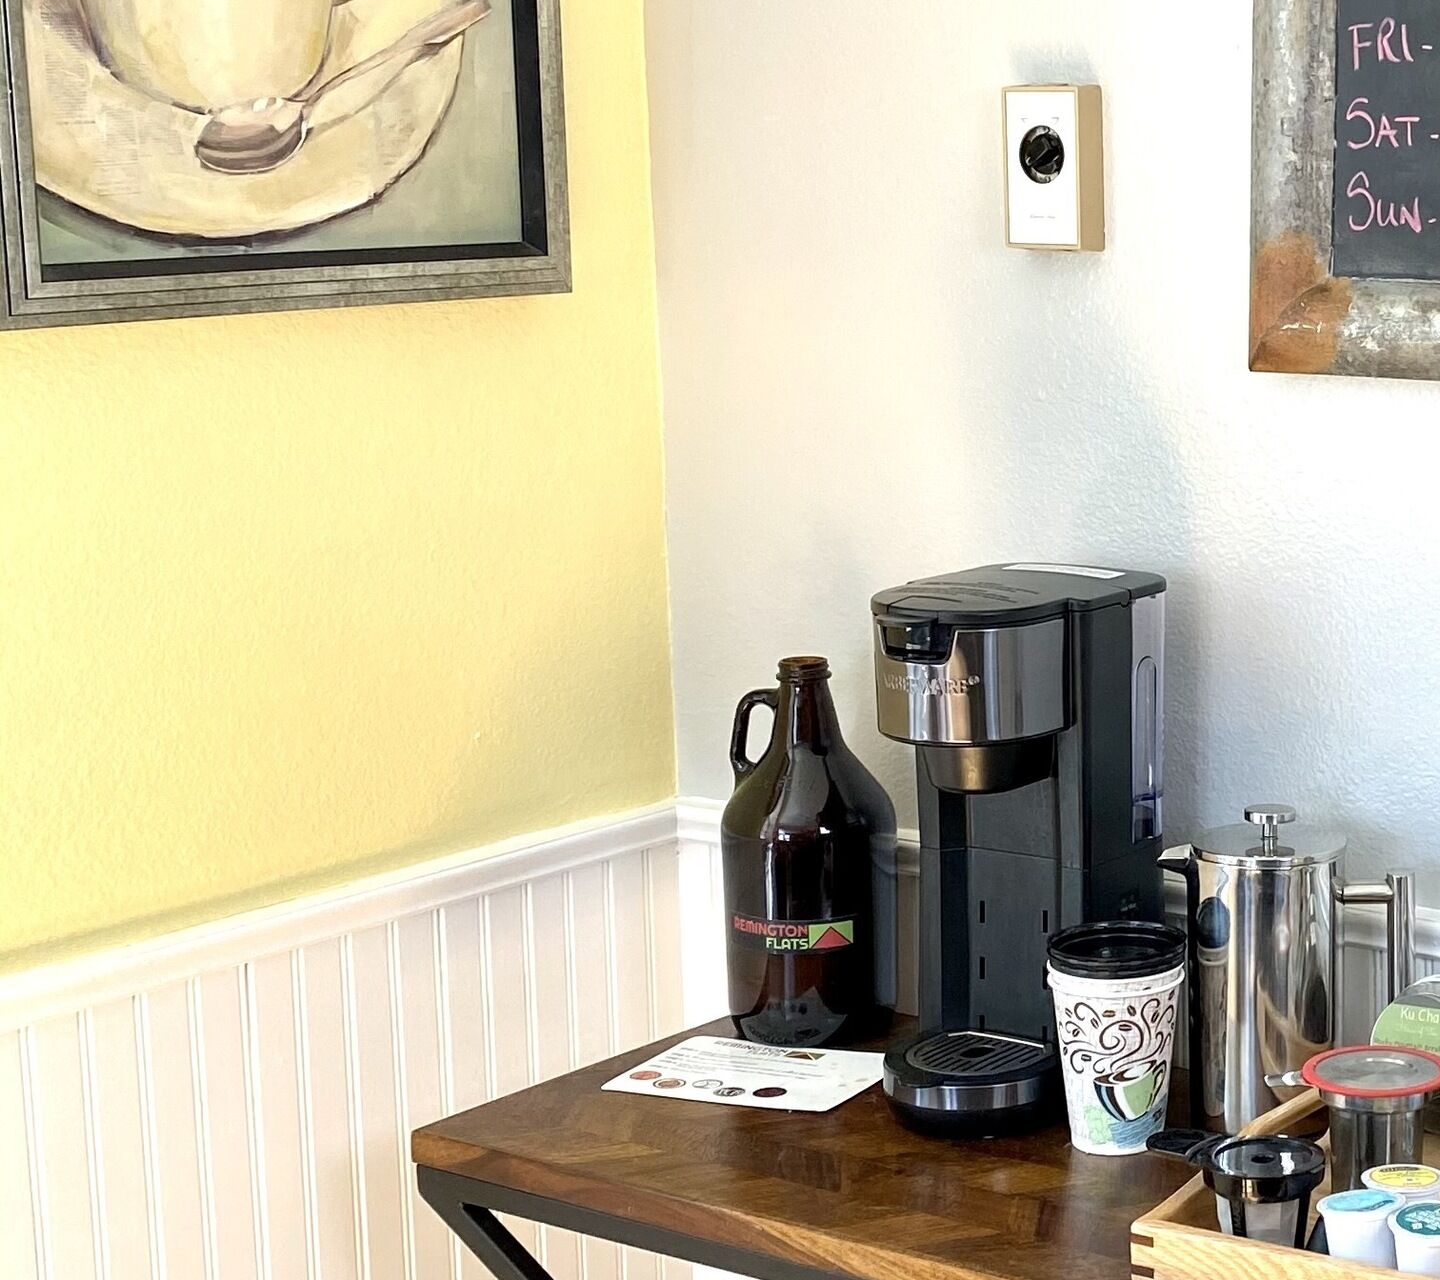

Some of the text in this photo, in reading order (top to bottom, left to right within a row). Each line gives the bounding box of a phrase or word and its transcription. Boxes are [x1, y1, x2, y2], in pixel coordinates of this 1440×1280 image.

[733, 916, 808, 937] REMINGTON
[766, 938, 809, 950] FLATS
[1400, 1007, 1440, 1024] Ku Cha
